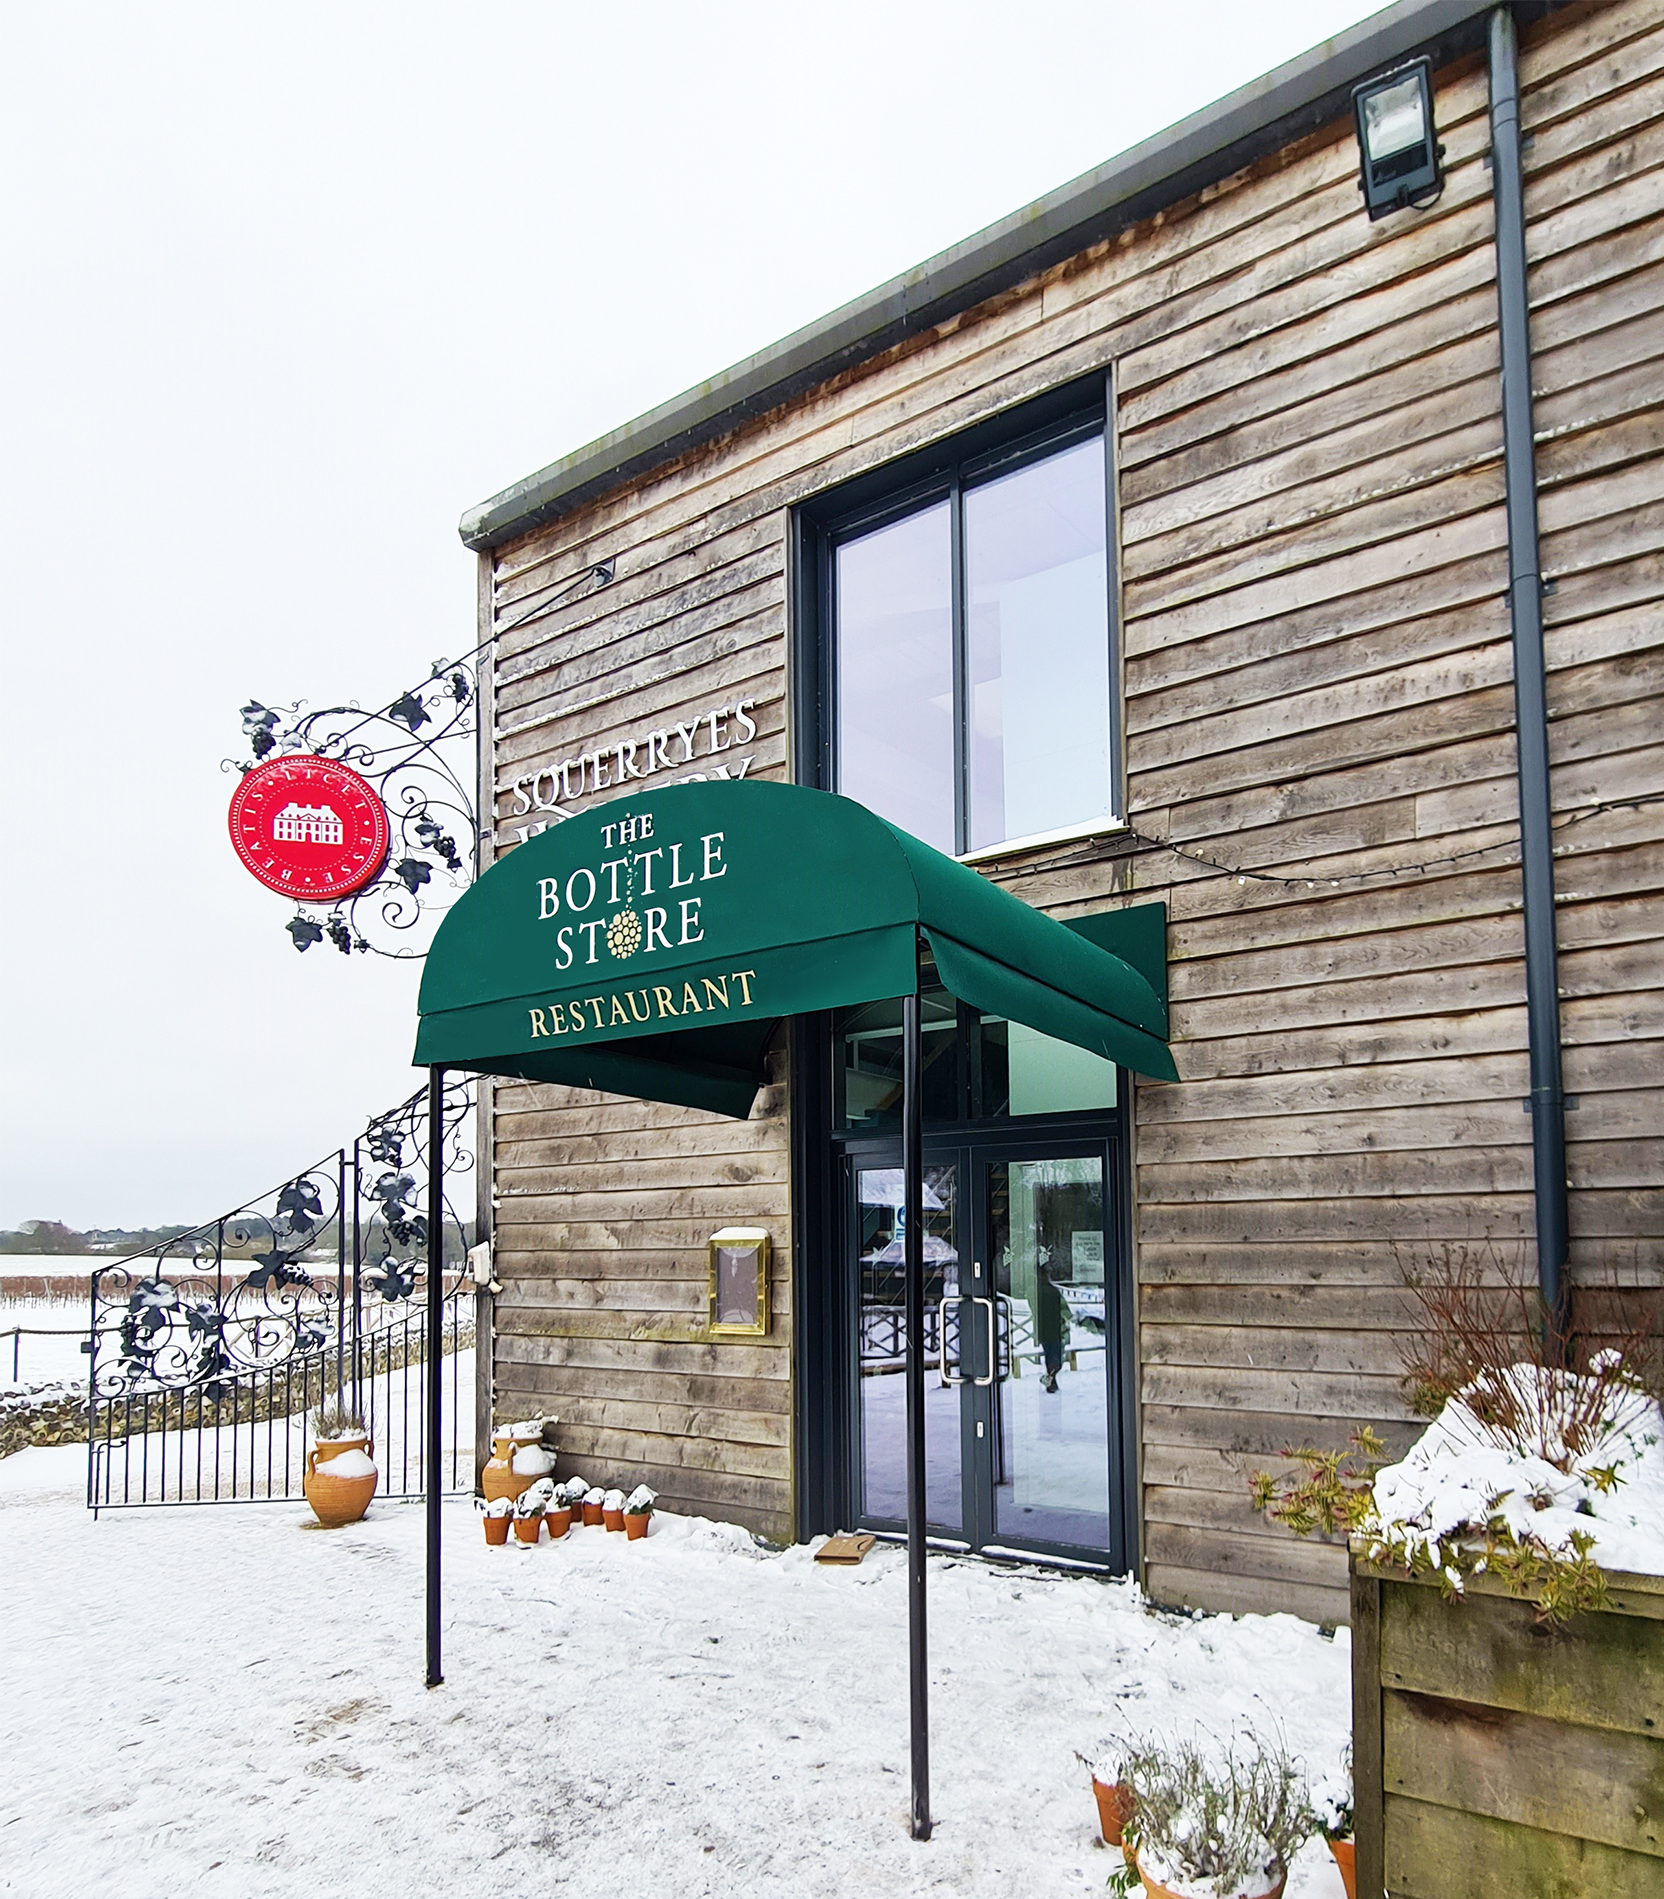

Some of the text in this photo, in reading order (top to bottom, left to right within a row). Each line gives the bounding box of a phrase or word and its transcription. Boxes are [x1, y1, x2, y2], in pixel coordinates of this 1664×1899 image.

[513, 697, 758, 818] SQUERRYES
[242, 768, 373, 883] LICET ESSE BEATIS
[600, 812, 655, 849] THE
[536, 831, 728, 920] BOTTLE
[555, 897, 705, 970] STORE
[528, 970, 756, 1039] RESTAURANT
